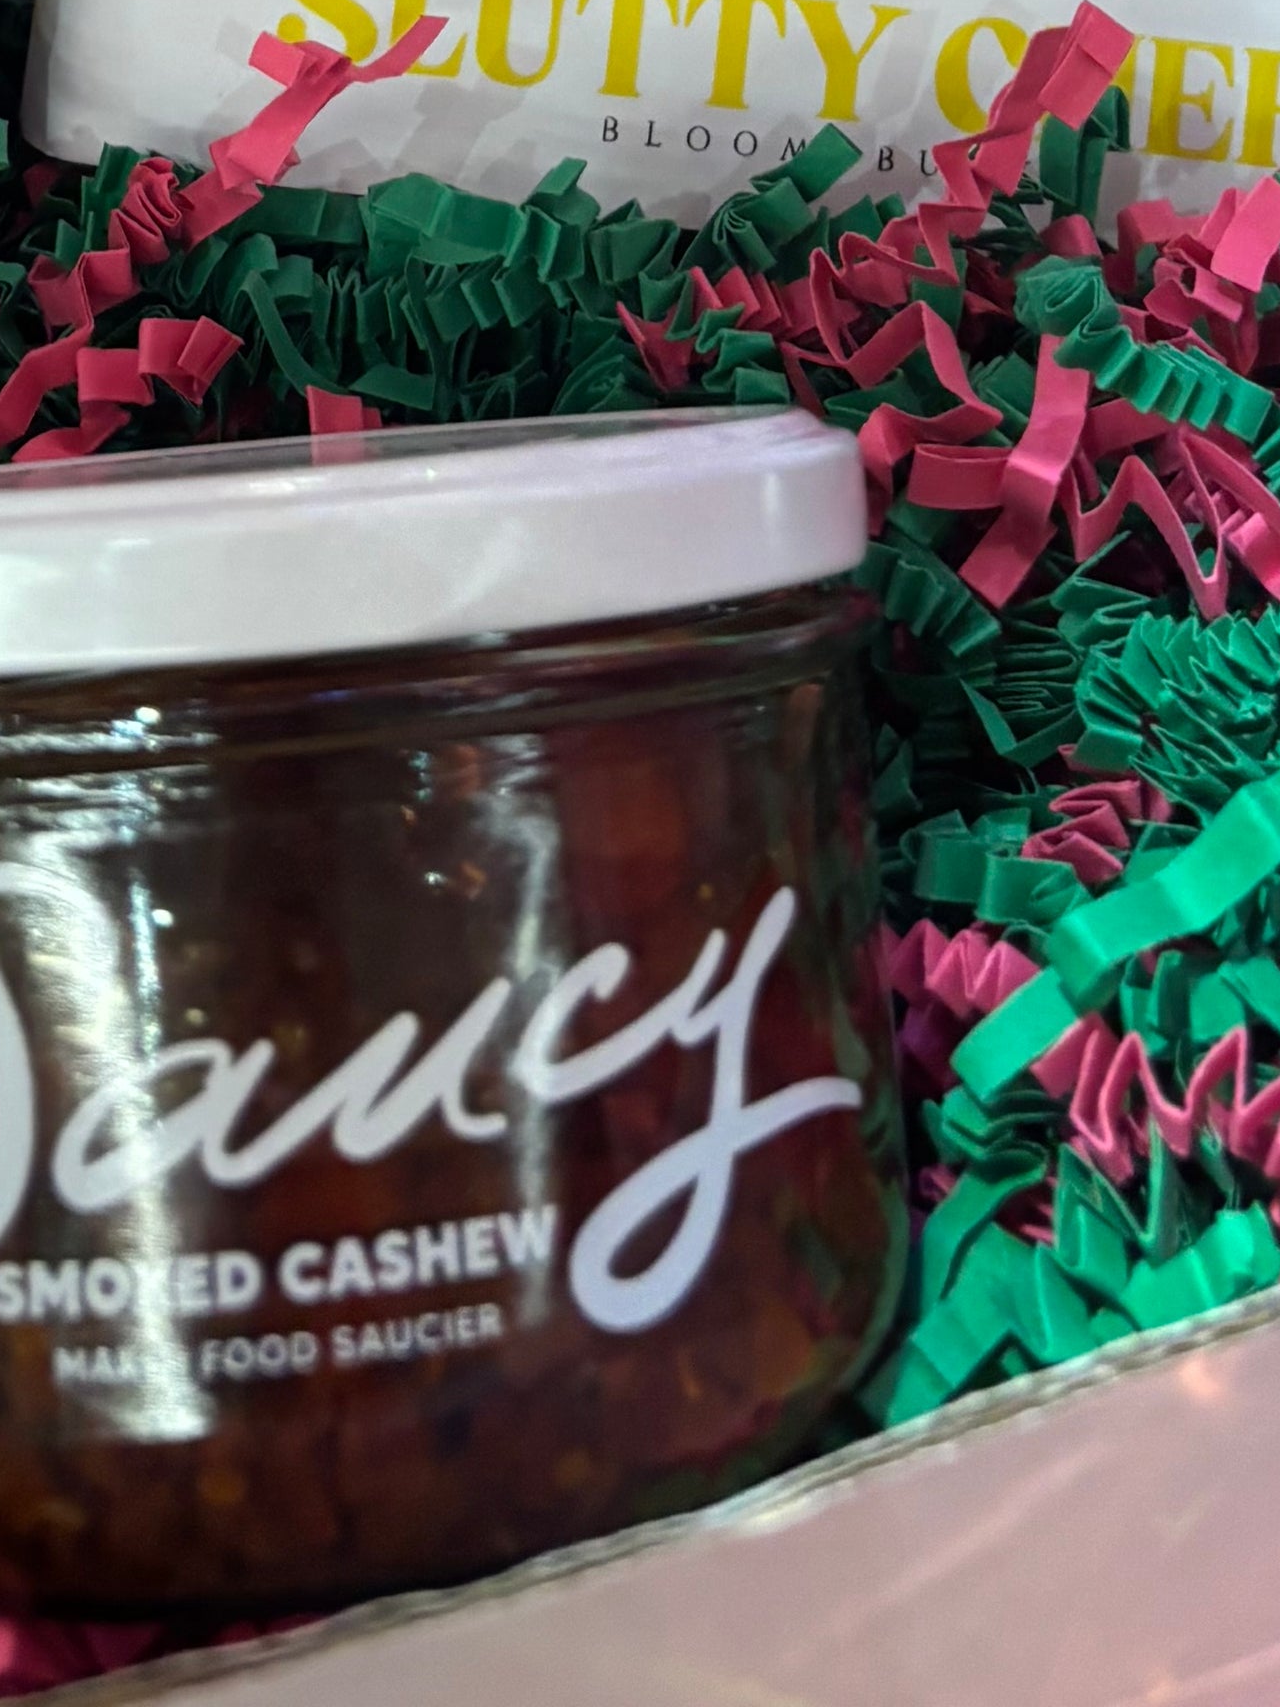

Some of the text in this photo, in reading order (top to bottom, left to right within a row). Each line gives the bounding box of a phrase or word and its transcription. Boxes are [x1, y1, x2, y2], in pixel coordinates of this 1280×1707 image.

[279, 1204, 559, 1304] CASHEW
[201, 1331, 318, 1379] FOOD
[331, 1303, 502, 1368] SAUCIER
